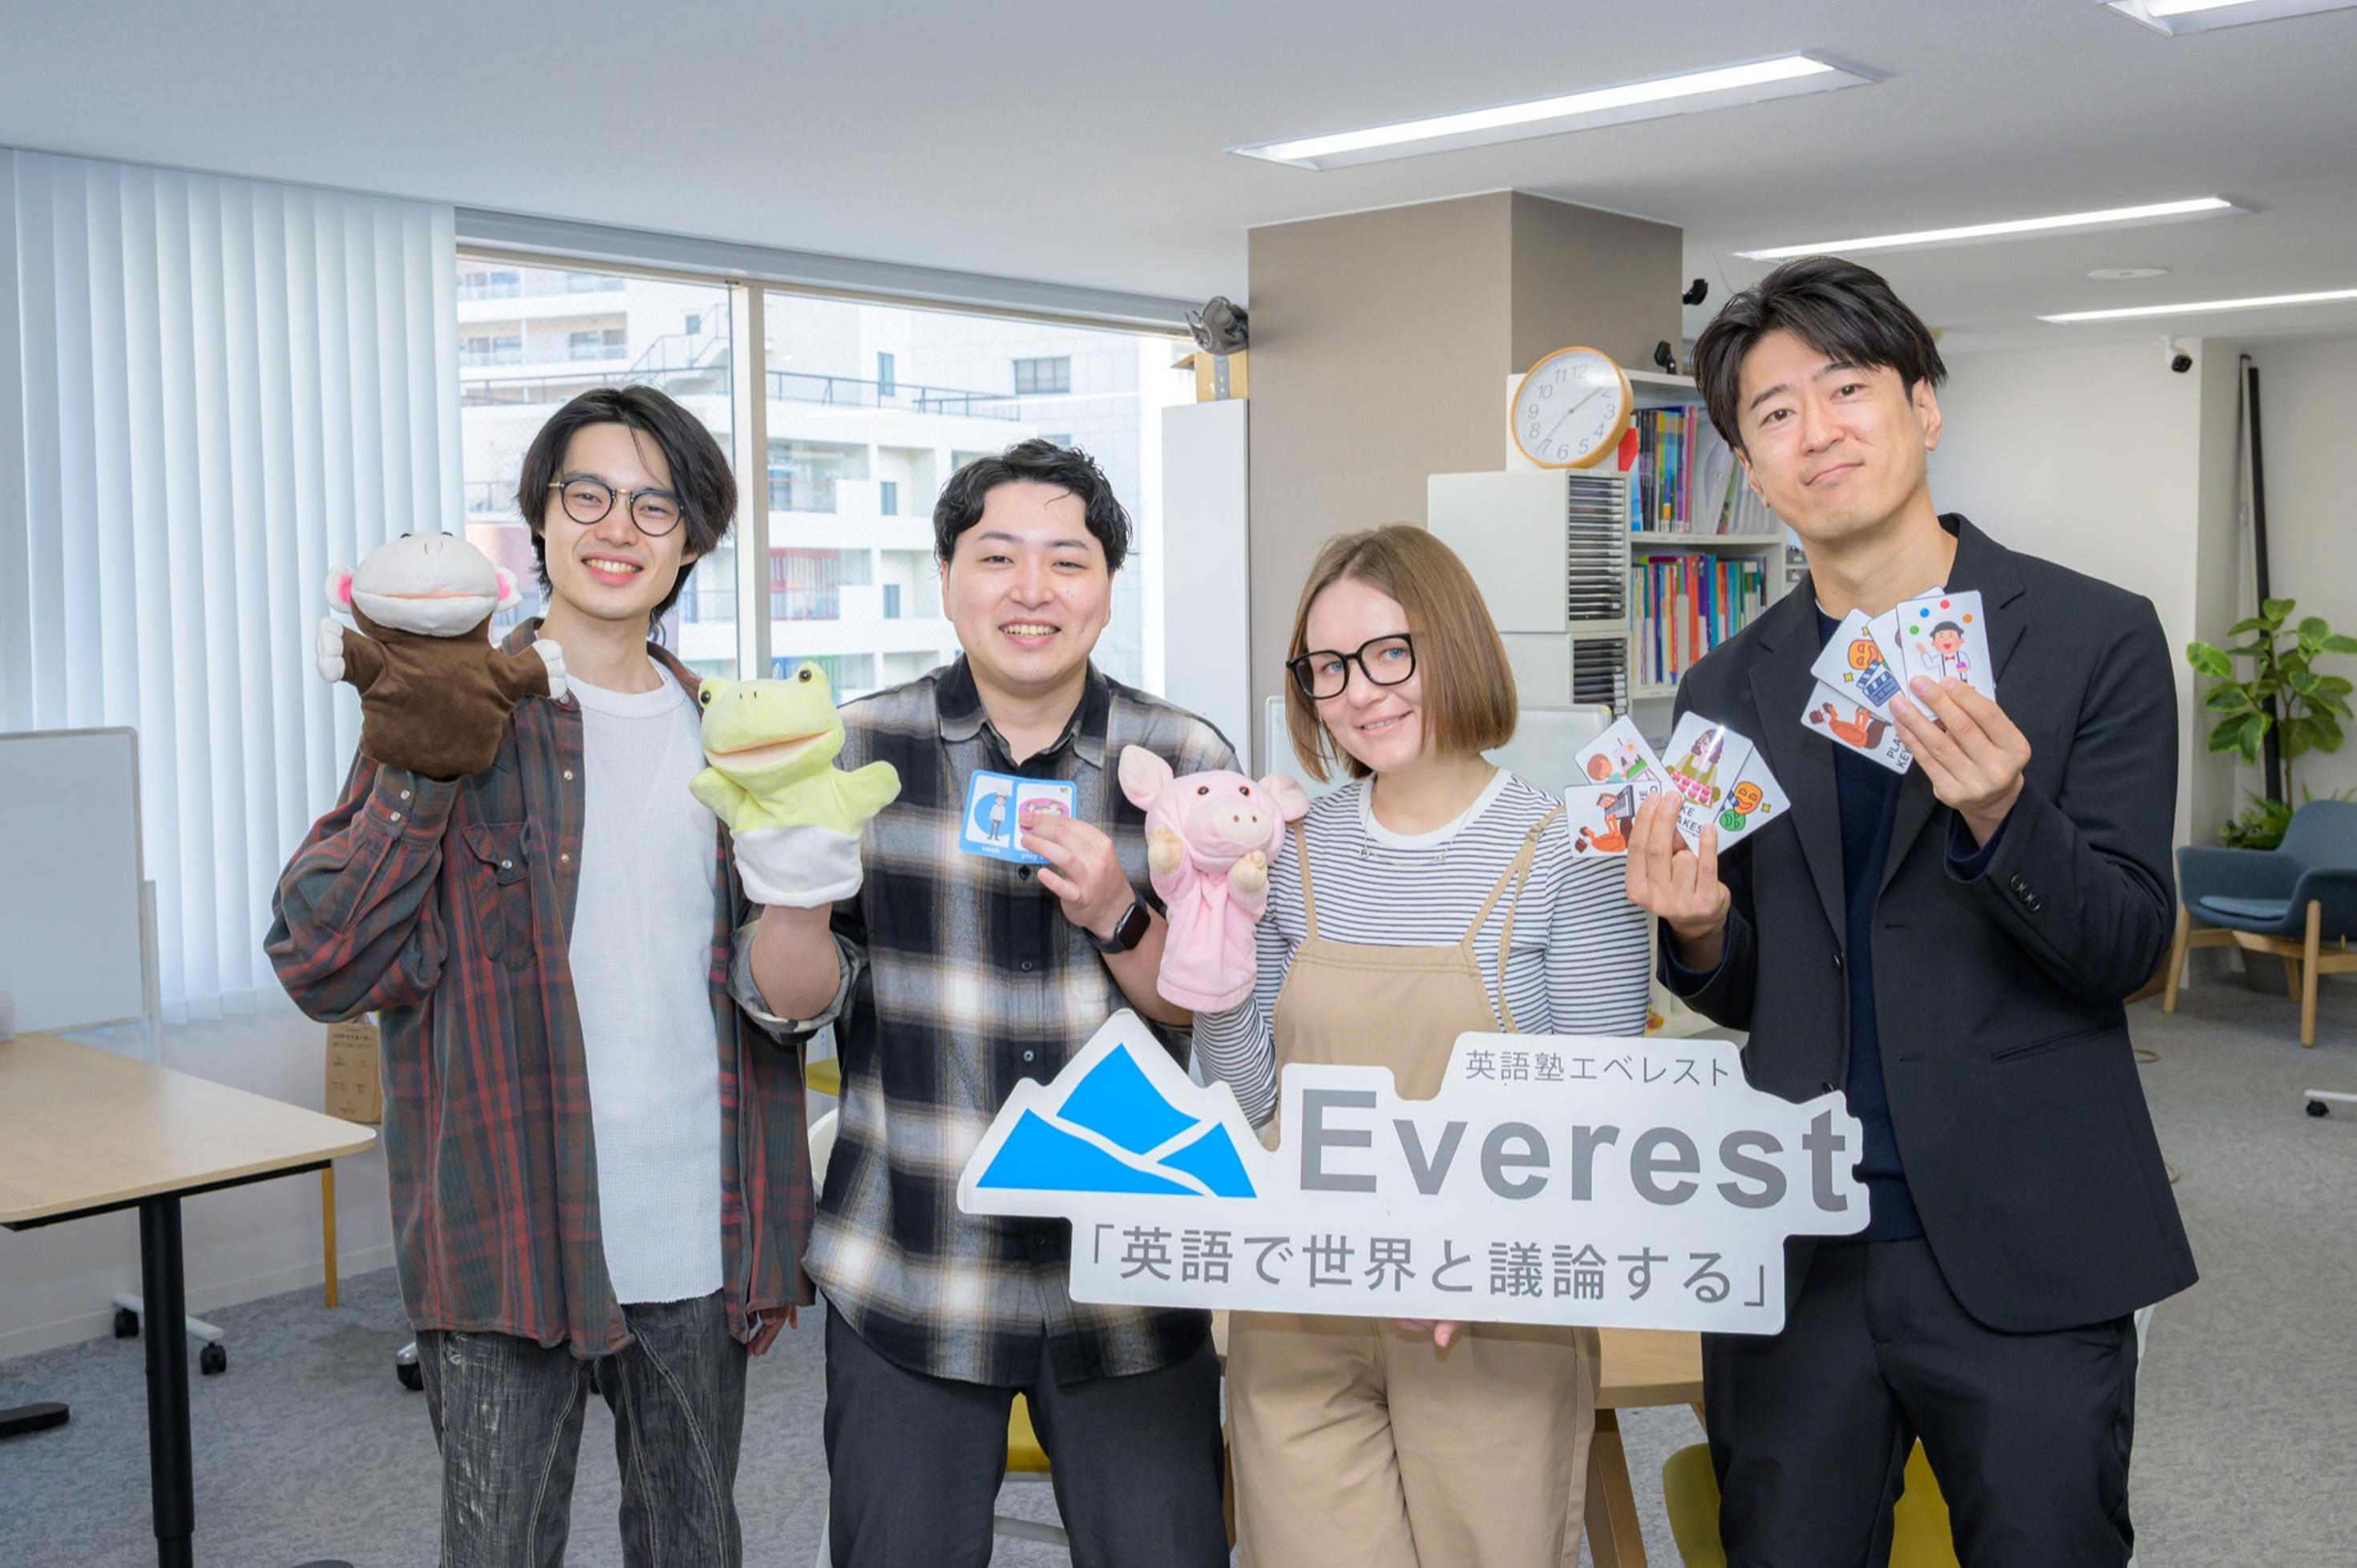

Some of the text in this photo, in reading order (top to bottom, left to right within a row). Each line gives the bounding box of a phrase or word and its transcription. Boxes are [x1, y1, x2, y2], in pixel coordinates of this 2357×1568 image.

[1554, 369, 1567, 383] 11
[1571, 364, 1588, 380] 12
[1538, 384, 1554, 399] 10
[1527, 403, 1539, 419] 9
[1603, 403, 1616, 419] 3
[1529, 422, 1541, 438] 8
[1592, 422, 1604, 438] 4
[1542, 438, 1553, 455] 7
[1557, 443, 1569, 460] 6
[1578, 438, 1590, 455] 5
[1886, 733, 1901, 759] PLA
[1896, 745, 1911, 769] KEY
[1677, 815, 1703, 835] AKES
[1466, 1049, 1728, 1086] 英語塾エベレスト
[1300, 1089, 1848, 1212] Everest
[1094, 1222, 1765, 1307] 「英語で世界と議論する」
